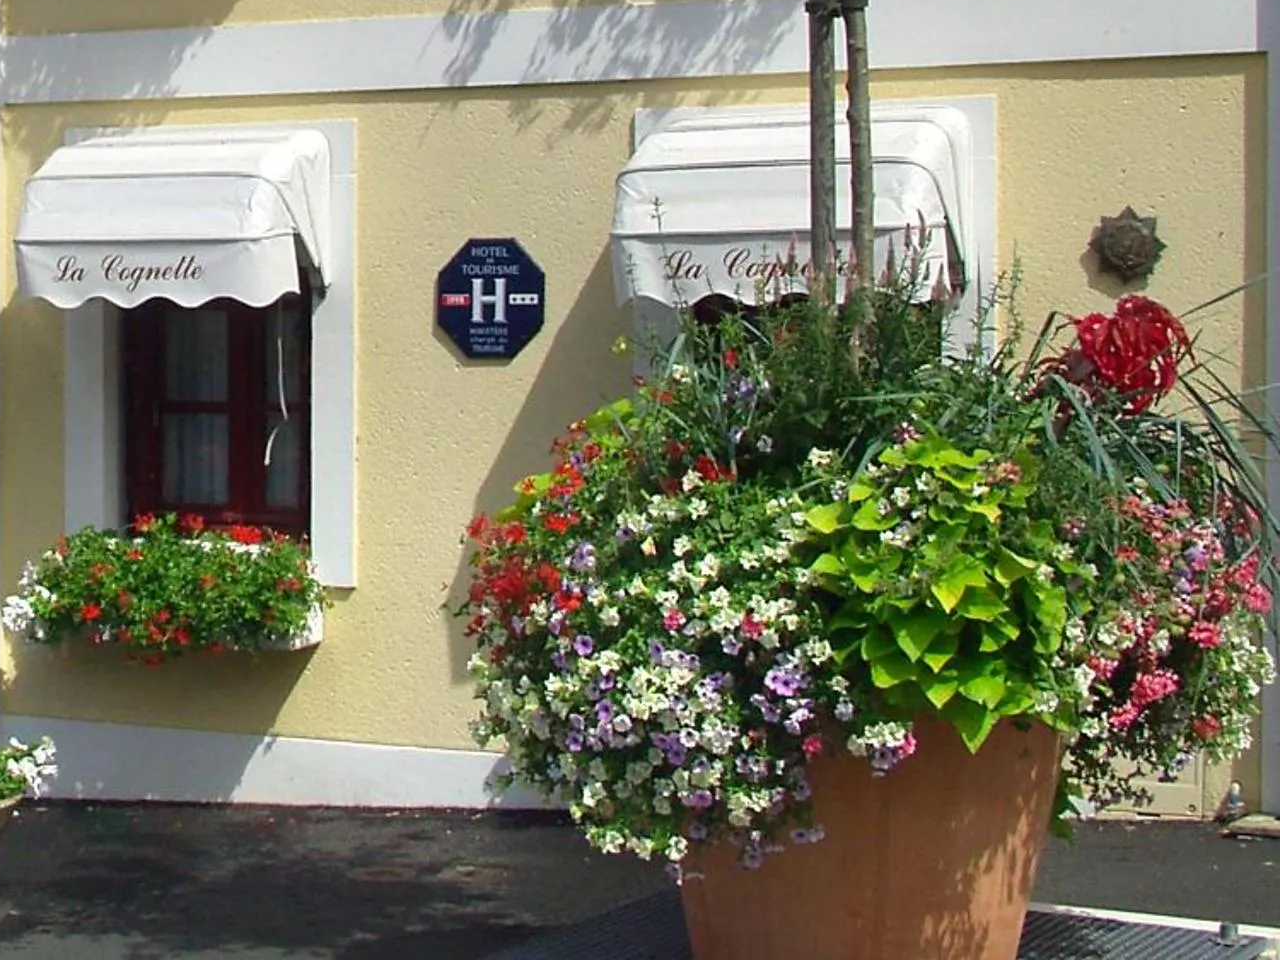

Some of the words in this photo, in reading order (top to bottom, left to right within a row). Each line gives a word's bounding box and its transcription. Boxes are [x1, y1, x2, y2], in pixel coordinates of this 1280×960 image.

[471, 246, 508, 258] HOTEL
[665, 249, 704, 281] La
[53, 253, 86, 283] La
[100, 254, 204, 293] Cognette
[462, 264, 520, 276] TOURISME
[471, 278, 508, 324] H
